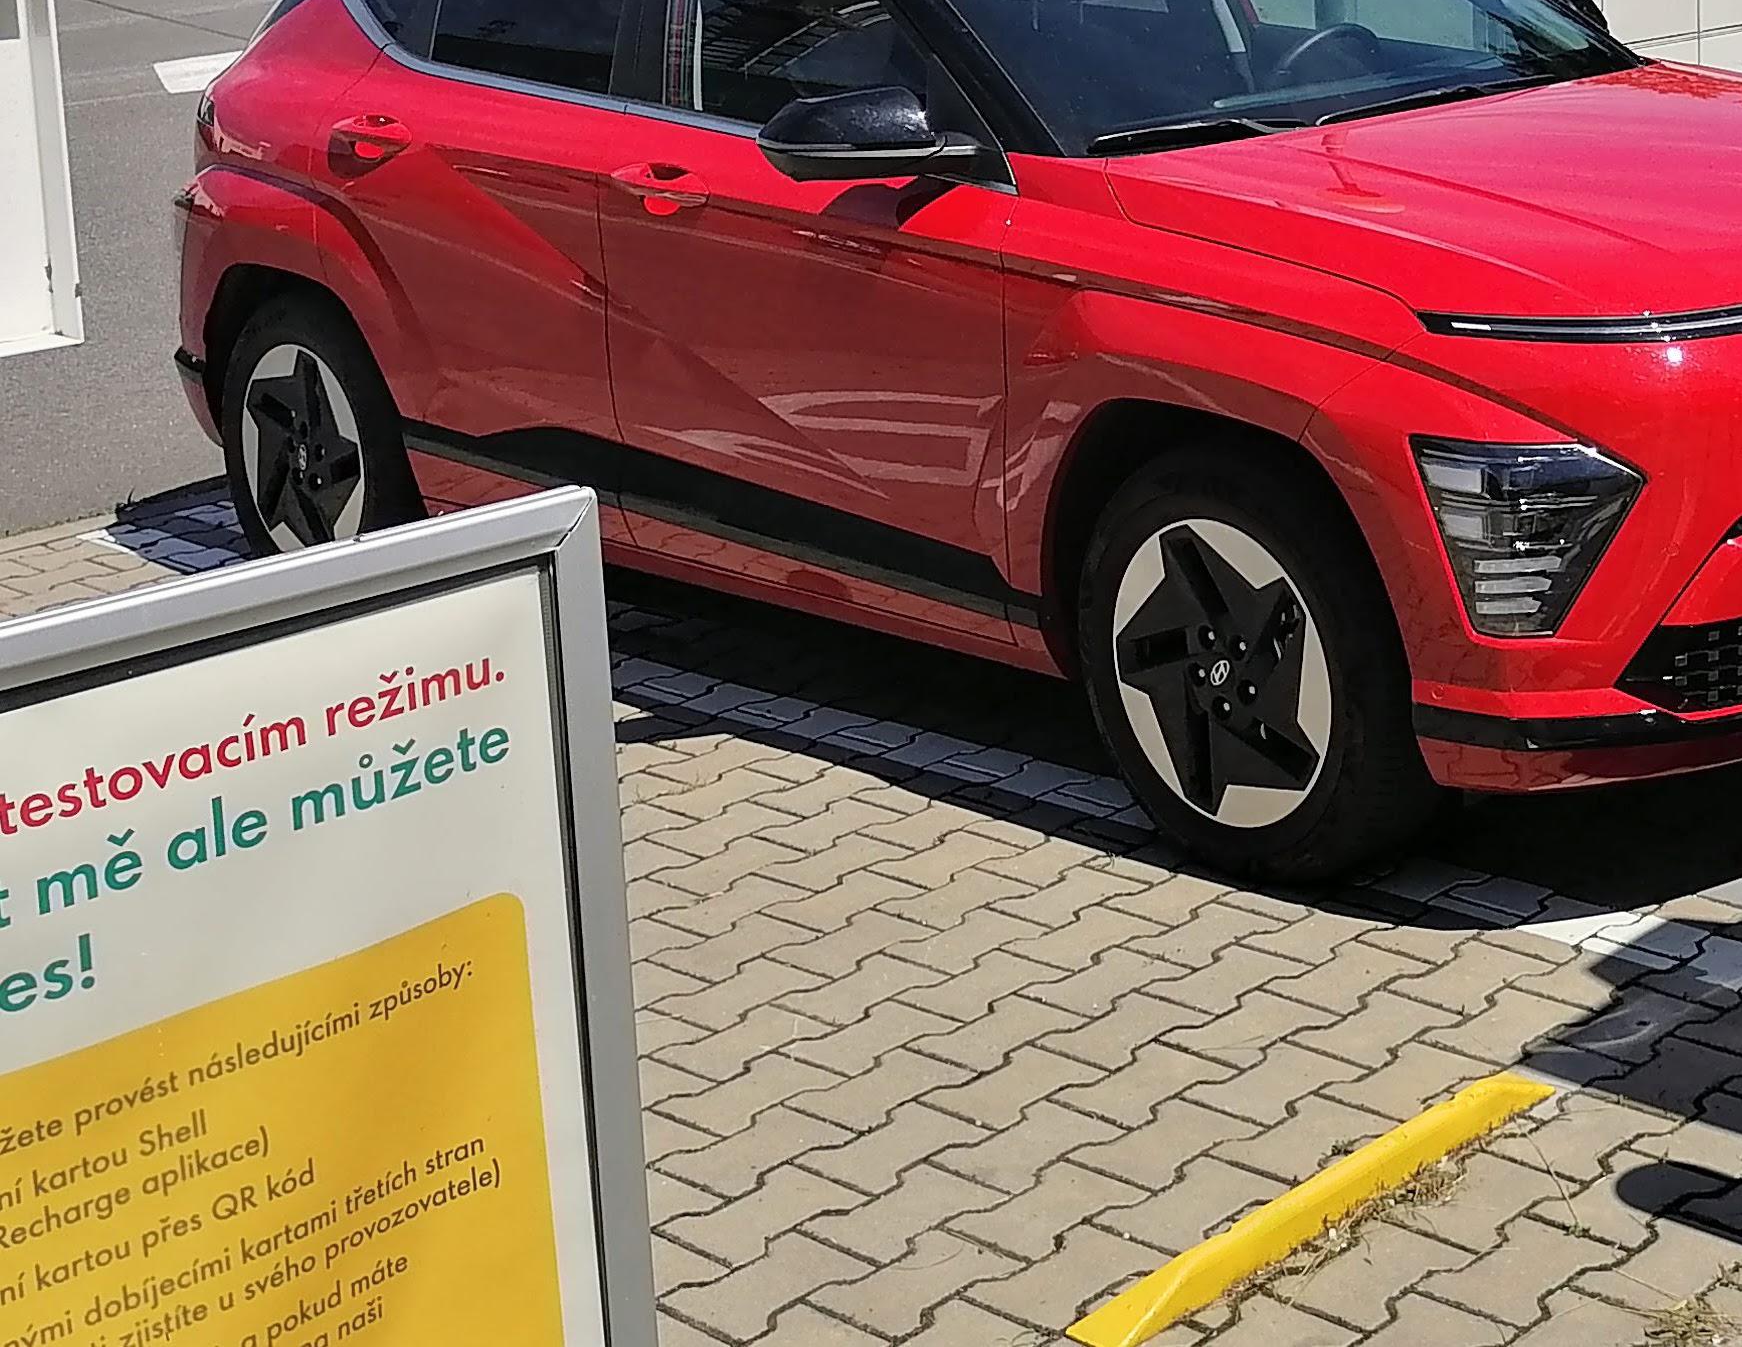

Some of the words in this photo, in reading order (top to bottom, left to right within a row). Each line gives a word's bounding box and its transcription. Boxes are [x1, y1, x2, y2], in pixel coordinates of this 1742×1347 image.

[0, 714, 305, 834] testovacím
[326, 657, 506, 737] režimu.
[36, 828, 144, 916] mě
[166, 796, 268, 871] ale
[291, 726, 510, 831] můžete
[0, 932, 96, 1013] es!
[74, 1071, 180, 1136] provést
[187, 1002, 361, 1087] následujícími
[368, 960, 473, 1021] způsoby:
[32, 1148, 128, 1198] kartou
[138, 1108, 207, 1157] Shell
[141, 1125, 270, 1197] aplikace)
[35, 1240, 131, 1291] kartou
[141, 1213, 203, 1258] přes
[211, 1184, 258, 1221] QR
[266, 1157, 315, 1201] kód
[84, 1246, 232, 1327] dobíjecími
[240, 1199, 337, 1265] kartami
[345, 1160, 417, 1215] třetích
[425, 1138, 485, 1175] stran
[218, 1291, 234, 1312] u
[244, 1255, 316, 1301] svého
[324, 1157, 501, 1270] provozovatele)
[266, 1279, 342, 1347] pokud
[350, 1256, 408, 1298] máte
[337, 1295, 383, 1341] naši
